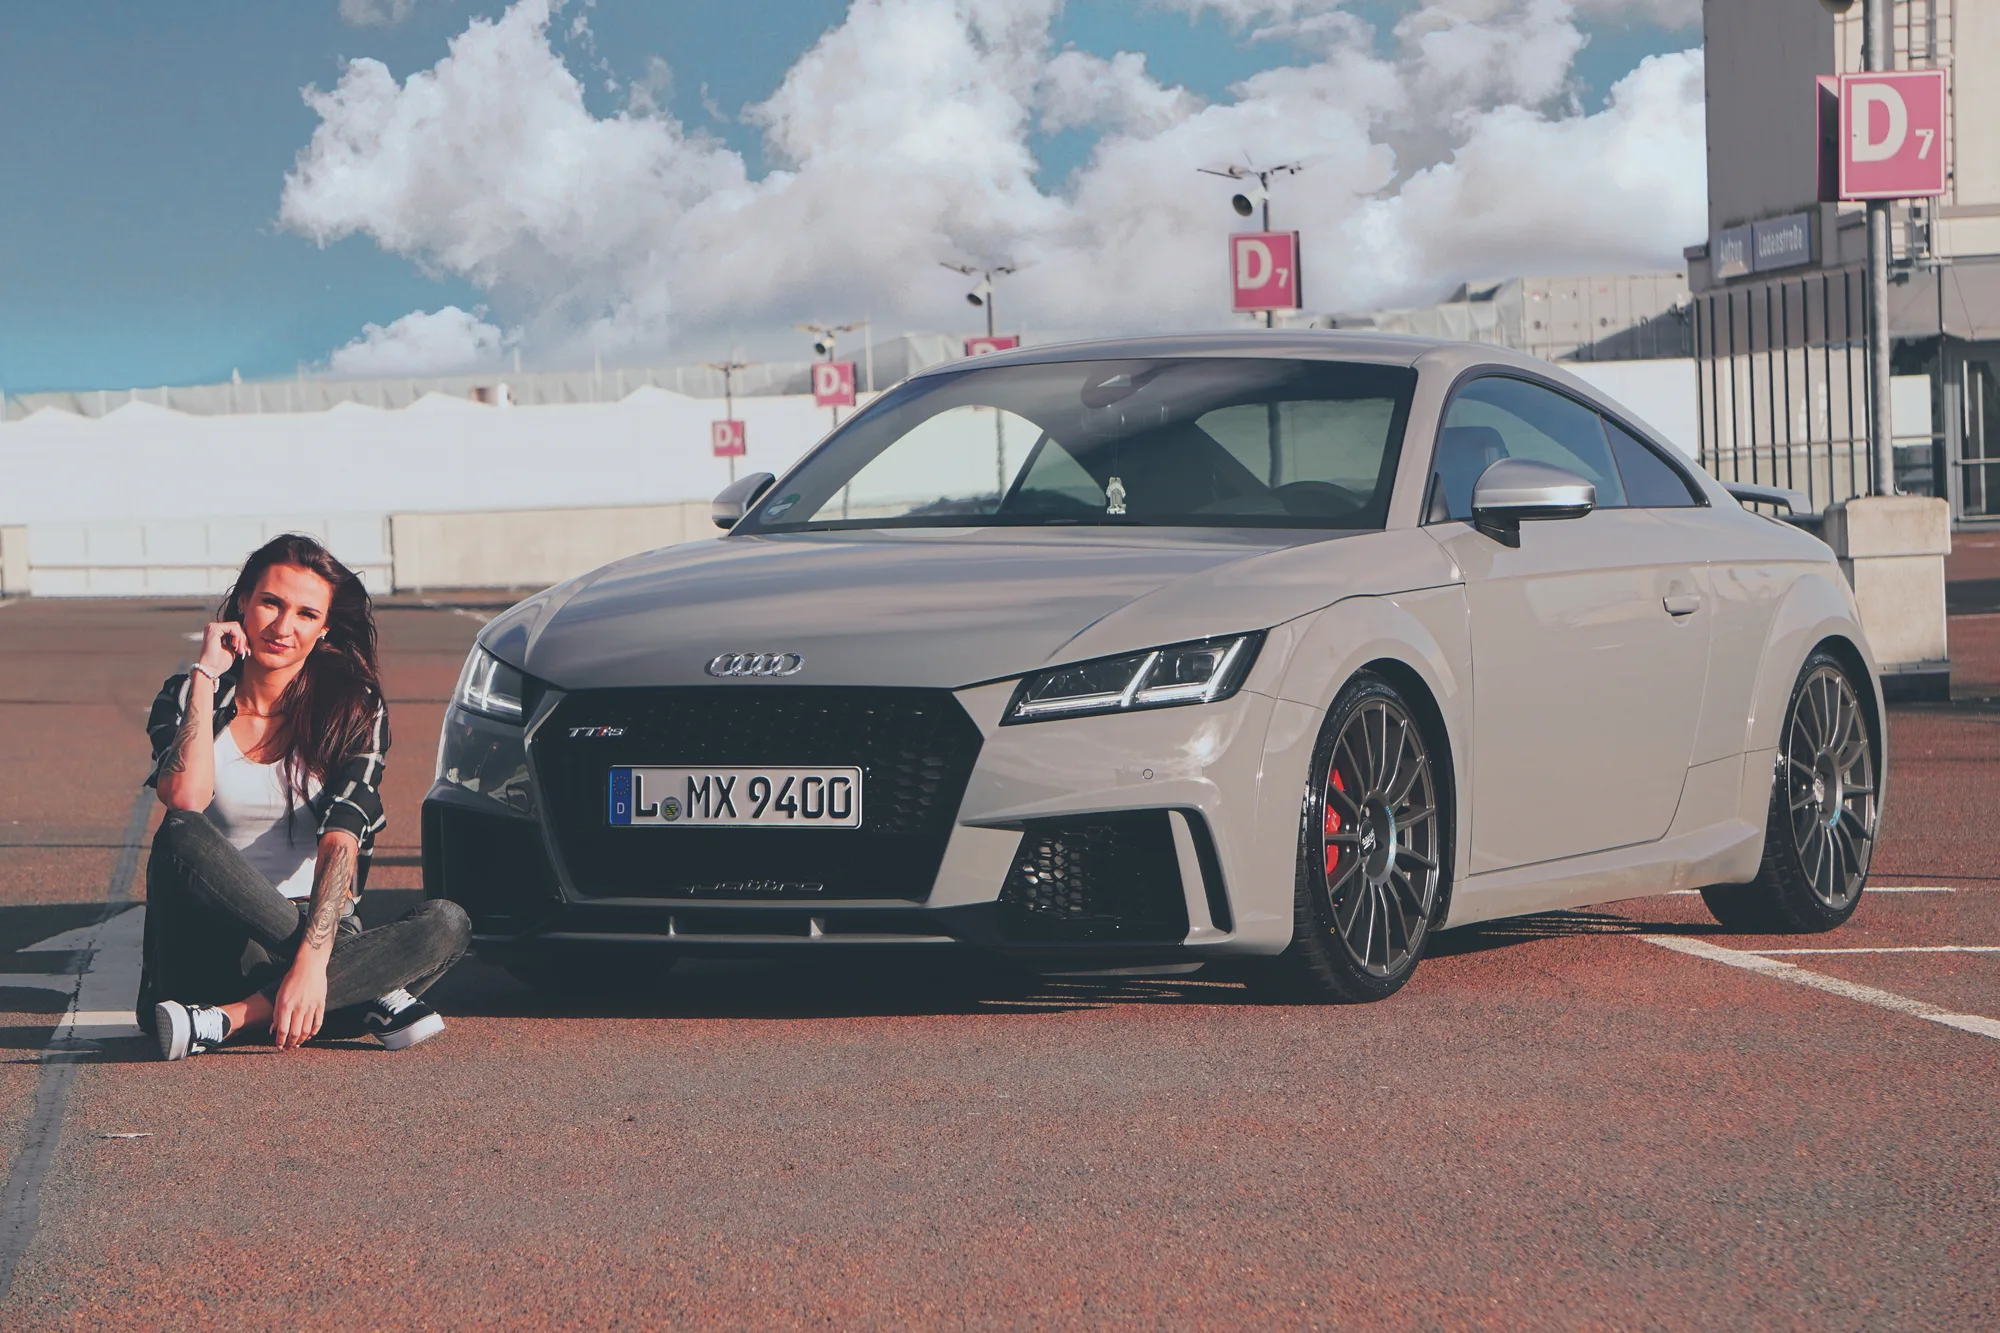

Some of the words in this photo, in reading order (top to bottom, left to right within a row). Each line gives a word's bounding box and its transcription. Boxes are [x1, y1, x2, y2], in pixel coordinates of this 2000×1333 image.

[617, 802, 625, 814] D
[635, 775, 658, 817] L
[687, 775, 738, 818] MX
[748, 776, 852, 818] 9400
